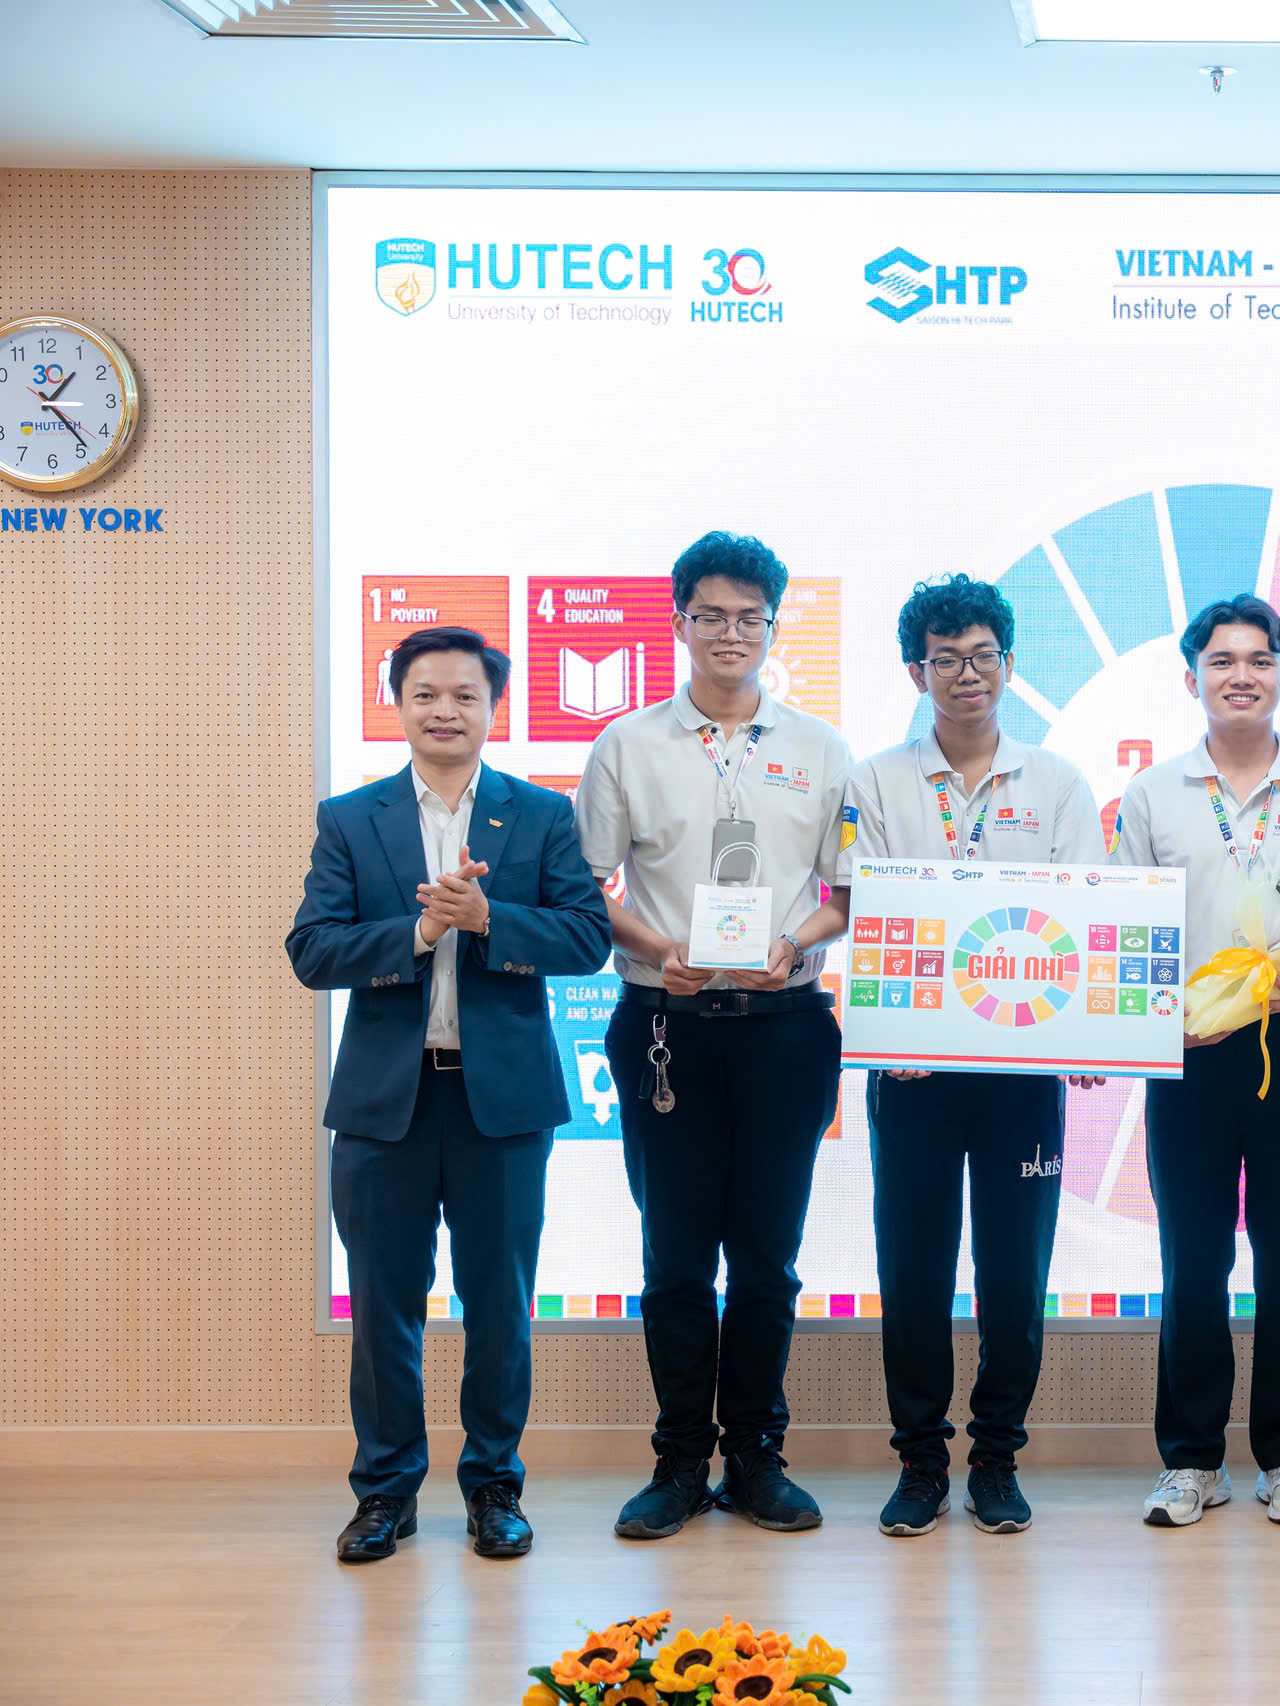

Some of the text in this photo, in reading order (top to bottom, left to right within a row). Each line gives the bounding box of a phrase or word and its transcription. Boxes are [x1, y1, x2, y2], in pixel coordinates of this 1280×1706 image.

[387, 243, 424, 252] HUTECH
[448, 243, 672, 290] HUTECH
[1115, 250, 1252, 277] VIETNAM
[448, 303, 672, 325] University of Technology
[691, 301, 783, 323] HUTECH
[1113, 295, 1196, 320] Institute
[1210, 293, 1232, 320] of
[10, 346, 25, 361] 11
[38, 338, 57, 354] 12
[75, 346, 83, 361] 1
[96, 365, 107, 381] 2
[105, 394, 117, 409] 3
[98, 423, 110, 438] 4
[17, 446, 28, 462] 7
[75, 443, 87, 459] 5
[47, 454, 58, 469] 6
[1, 508, 164, 532] NEW YORK
[368, 588, 406, 622] 1 NO
[537, 588, 609, 623] 4 QUALITY
[390, 609, 438, 623] POVERTY
[565, 609, 624, 624] EDUCATION
[765, 774, 789, 782] VIETNAM
[793, 779, 810, 788] JAPAN
[873, 865, 917, 875] HUTECH
[968, 946, 1064, 981] GIẢI NHÌ
[566, 986, 599, 1002] CLEAN
[566, 1007, 589, 1020] AND
[1020, 1144, 1062, 1177] PARIS
